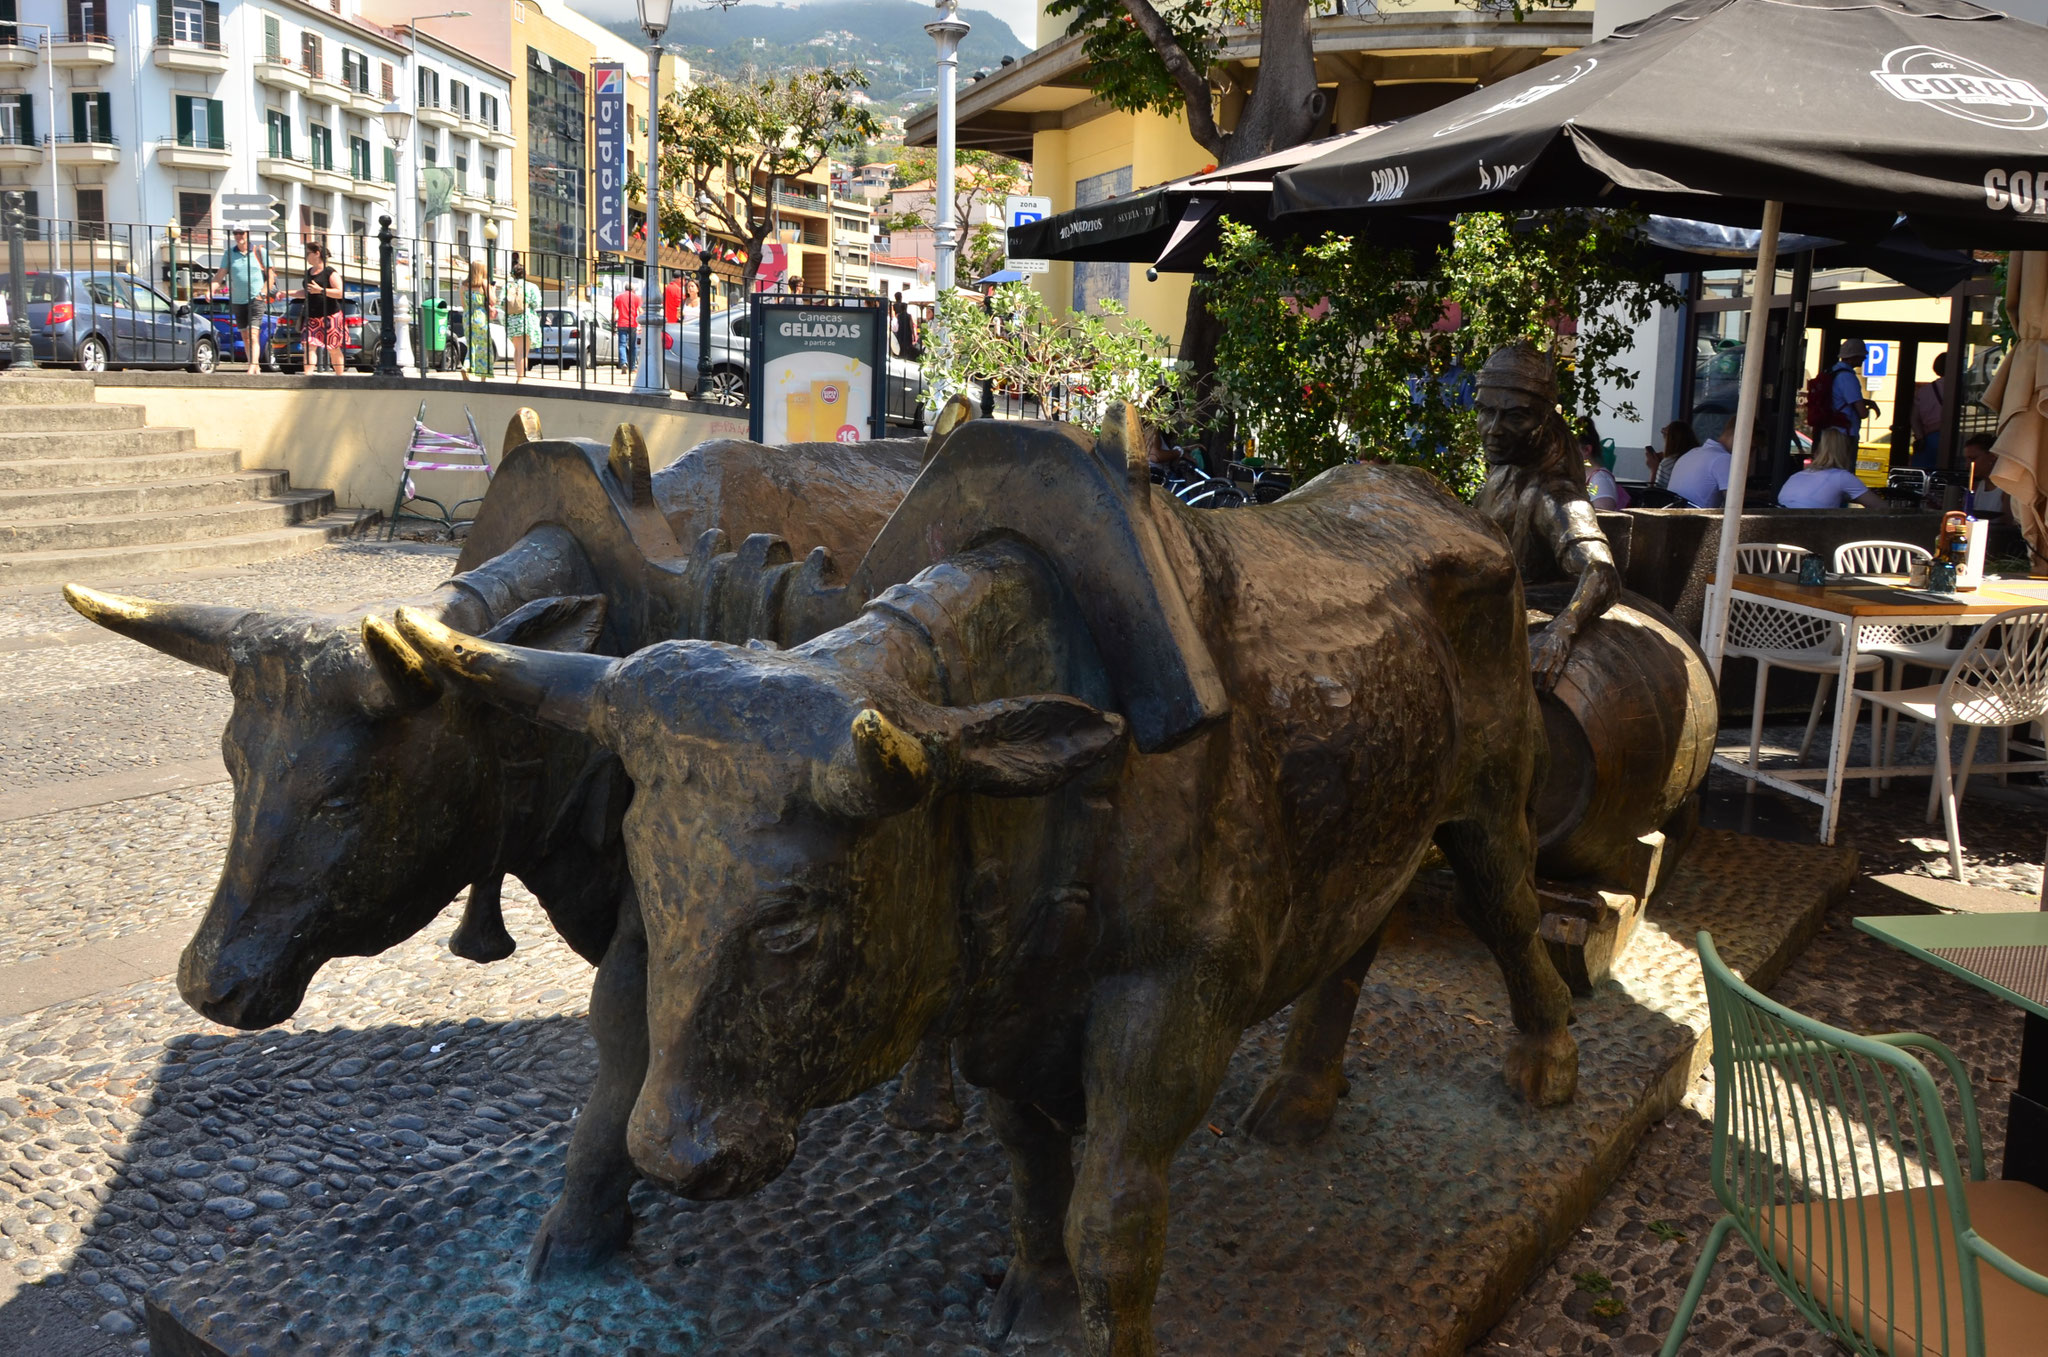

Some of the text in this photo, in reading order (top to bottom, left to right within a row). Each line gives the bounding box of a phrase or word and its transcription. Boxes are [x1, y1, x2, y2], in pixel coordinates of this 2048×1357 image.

[1901, 77, 2034, 102] CORAL
[599, 100, 613, 246] Anadia
[798, 311, 843, 323] Canecas
[779, 322, 861, 339] GELADAS
[1867, 345, 1884, 374] P
